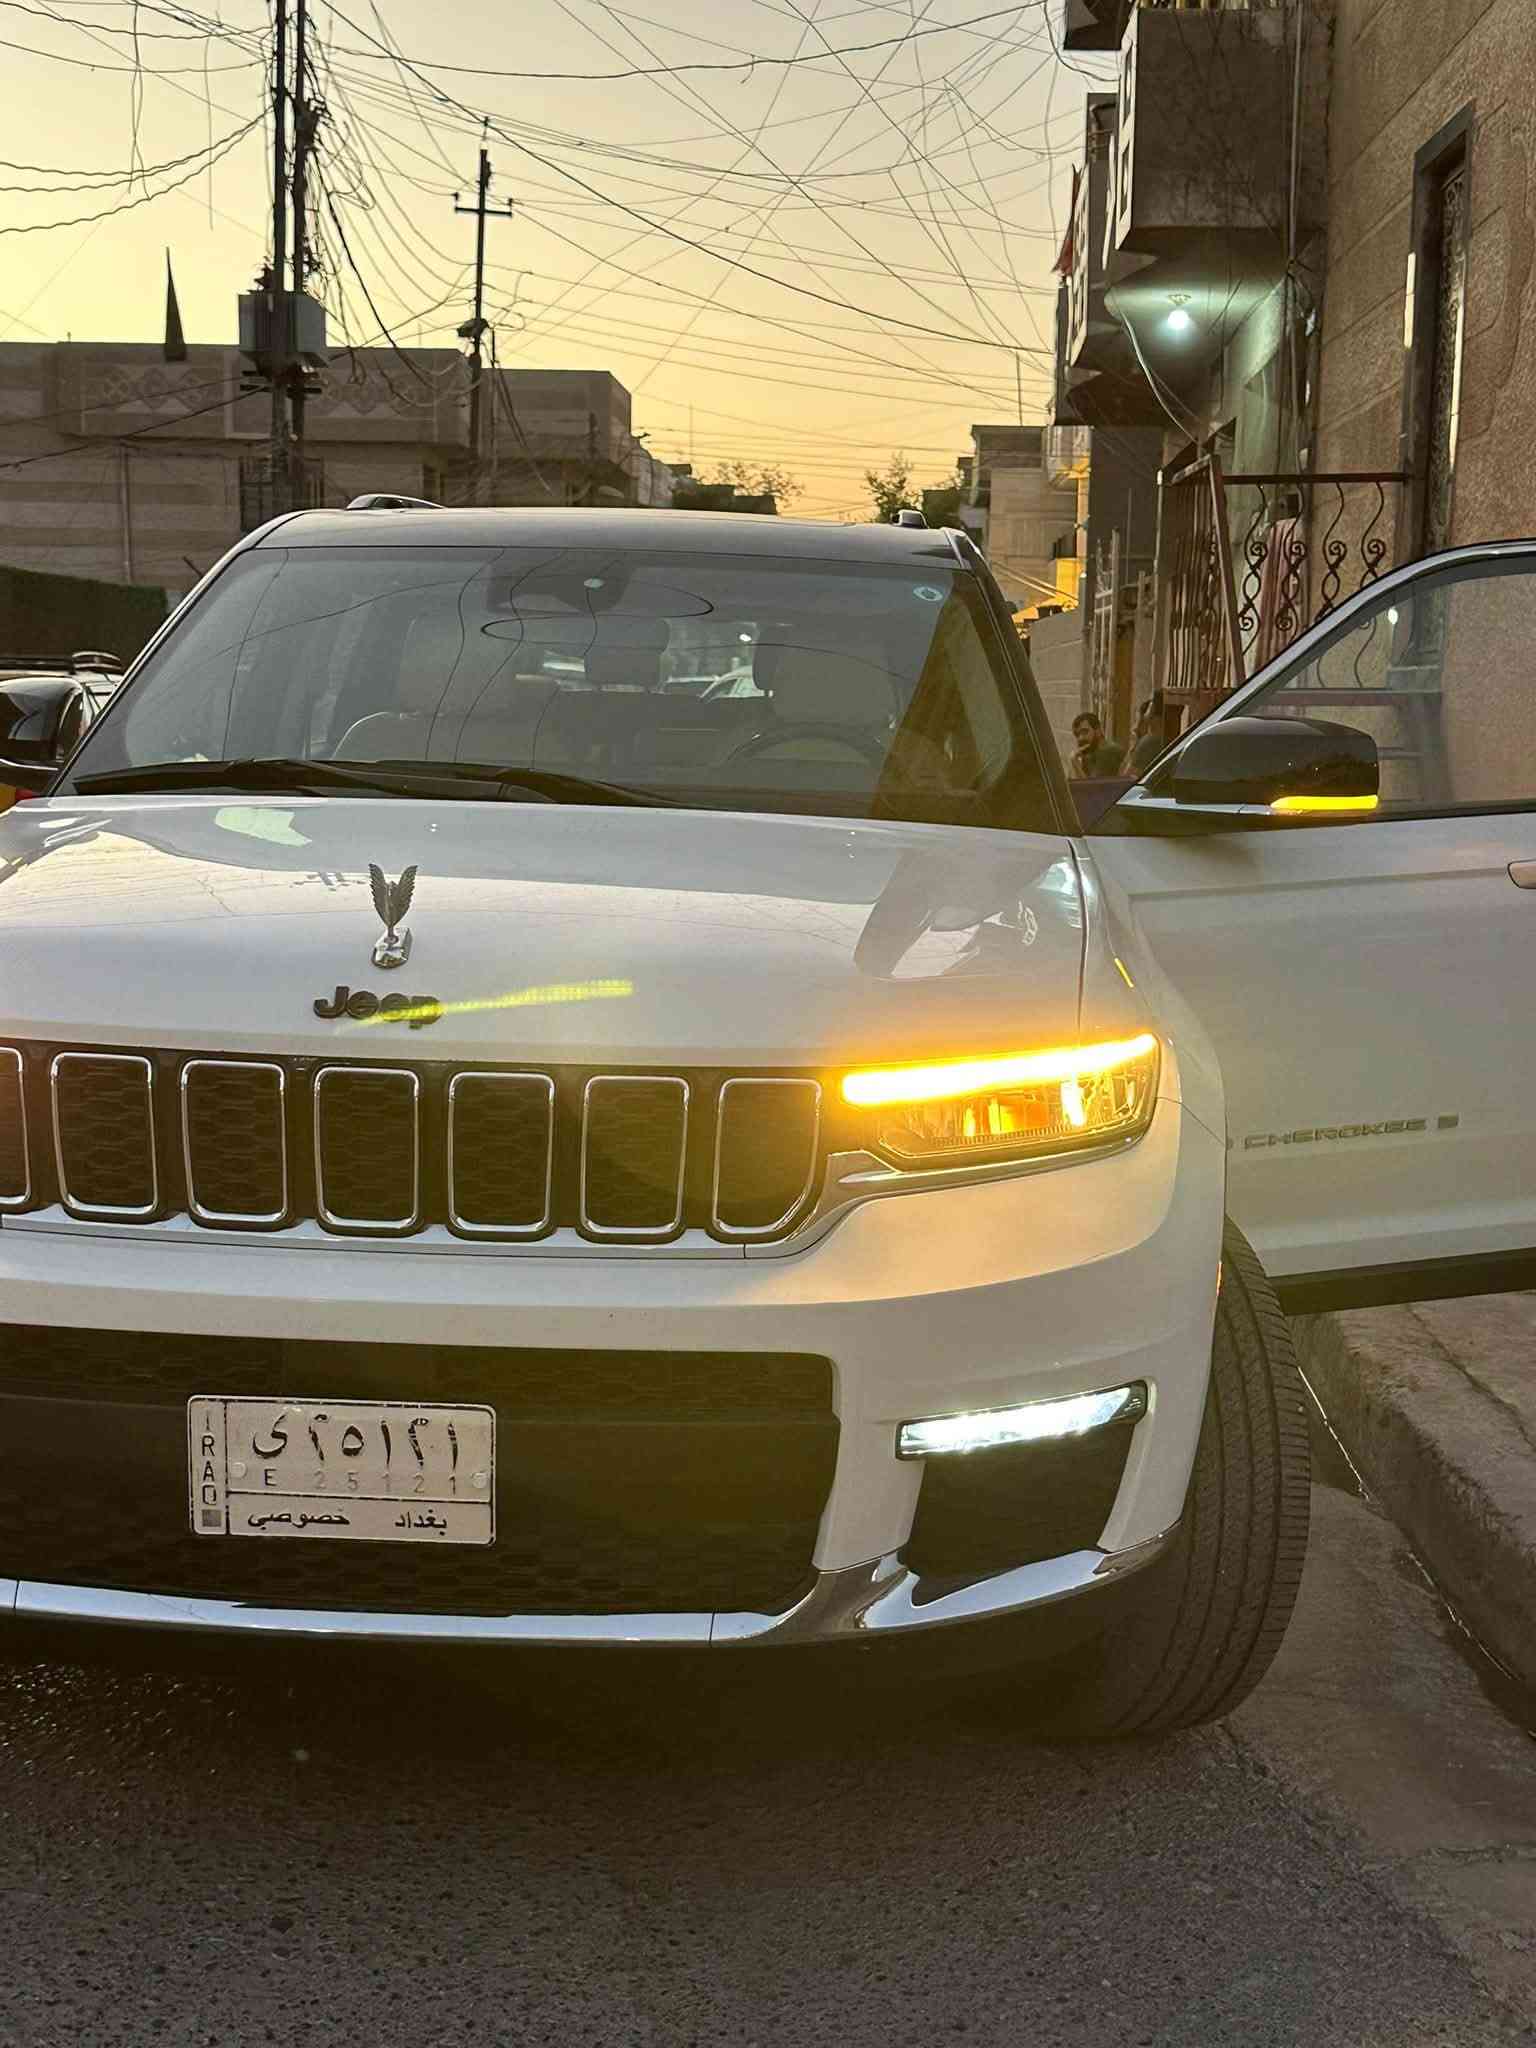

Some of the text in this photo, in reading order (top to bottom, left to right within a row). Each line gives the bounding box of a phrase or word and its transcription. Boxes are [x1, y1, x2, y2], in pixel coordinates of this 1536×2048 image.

[313, 985, 443, 1030] Jeep
[1244, 1118, 1428, 1150] CHEROKEE
[200, 1411, 218, 1505] IRAQ
[394, 1507, 448, 1536] بغداد
